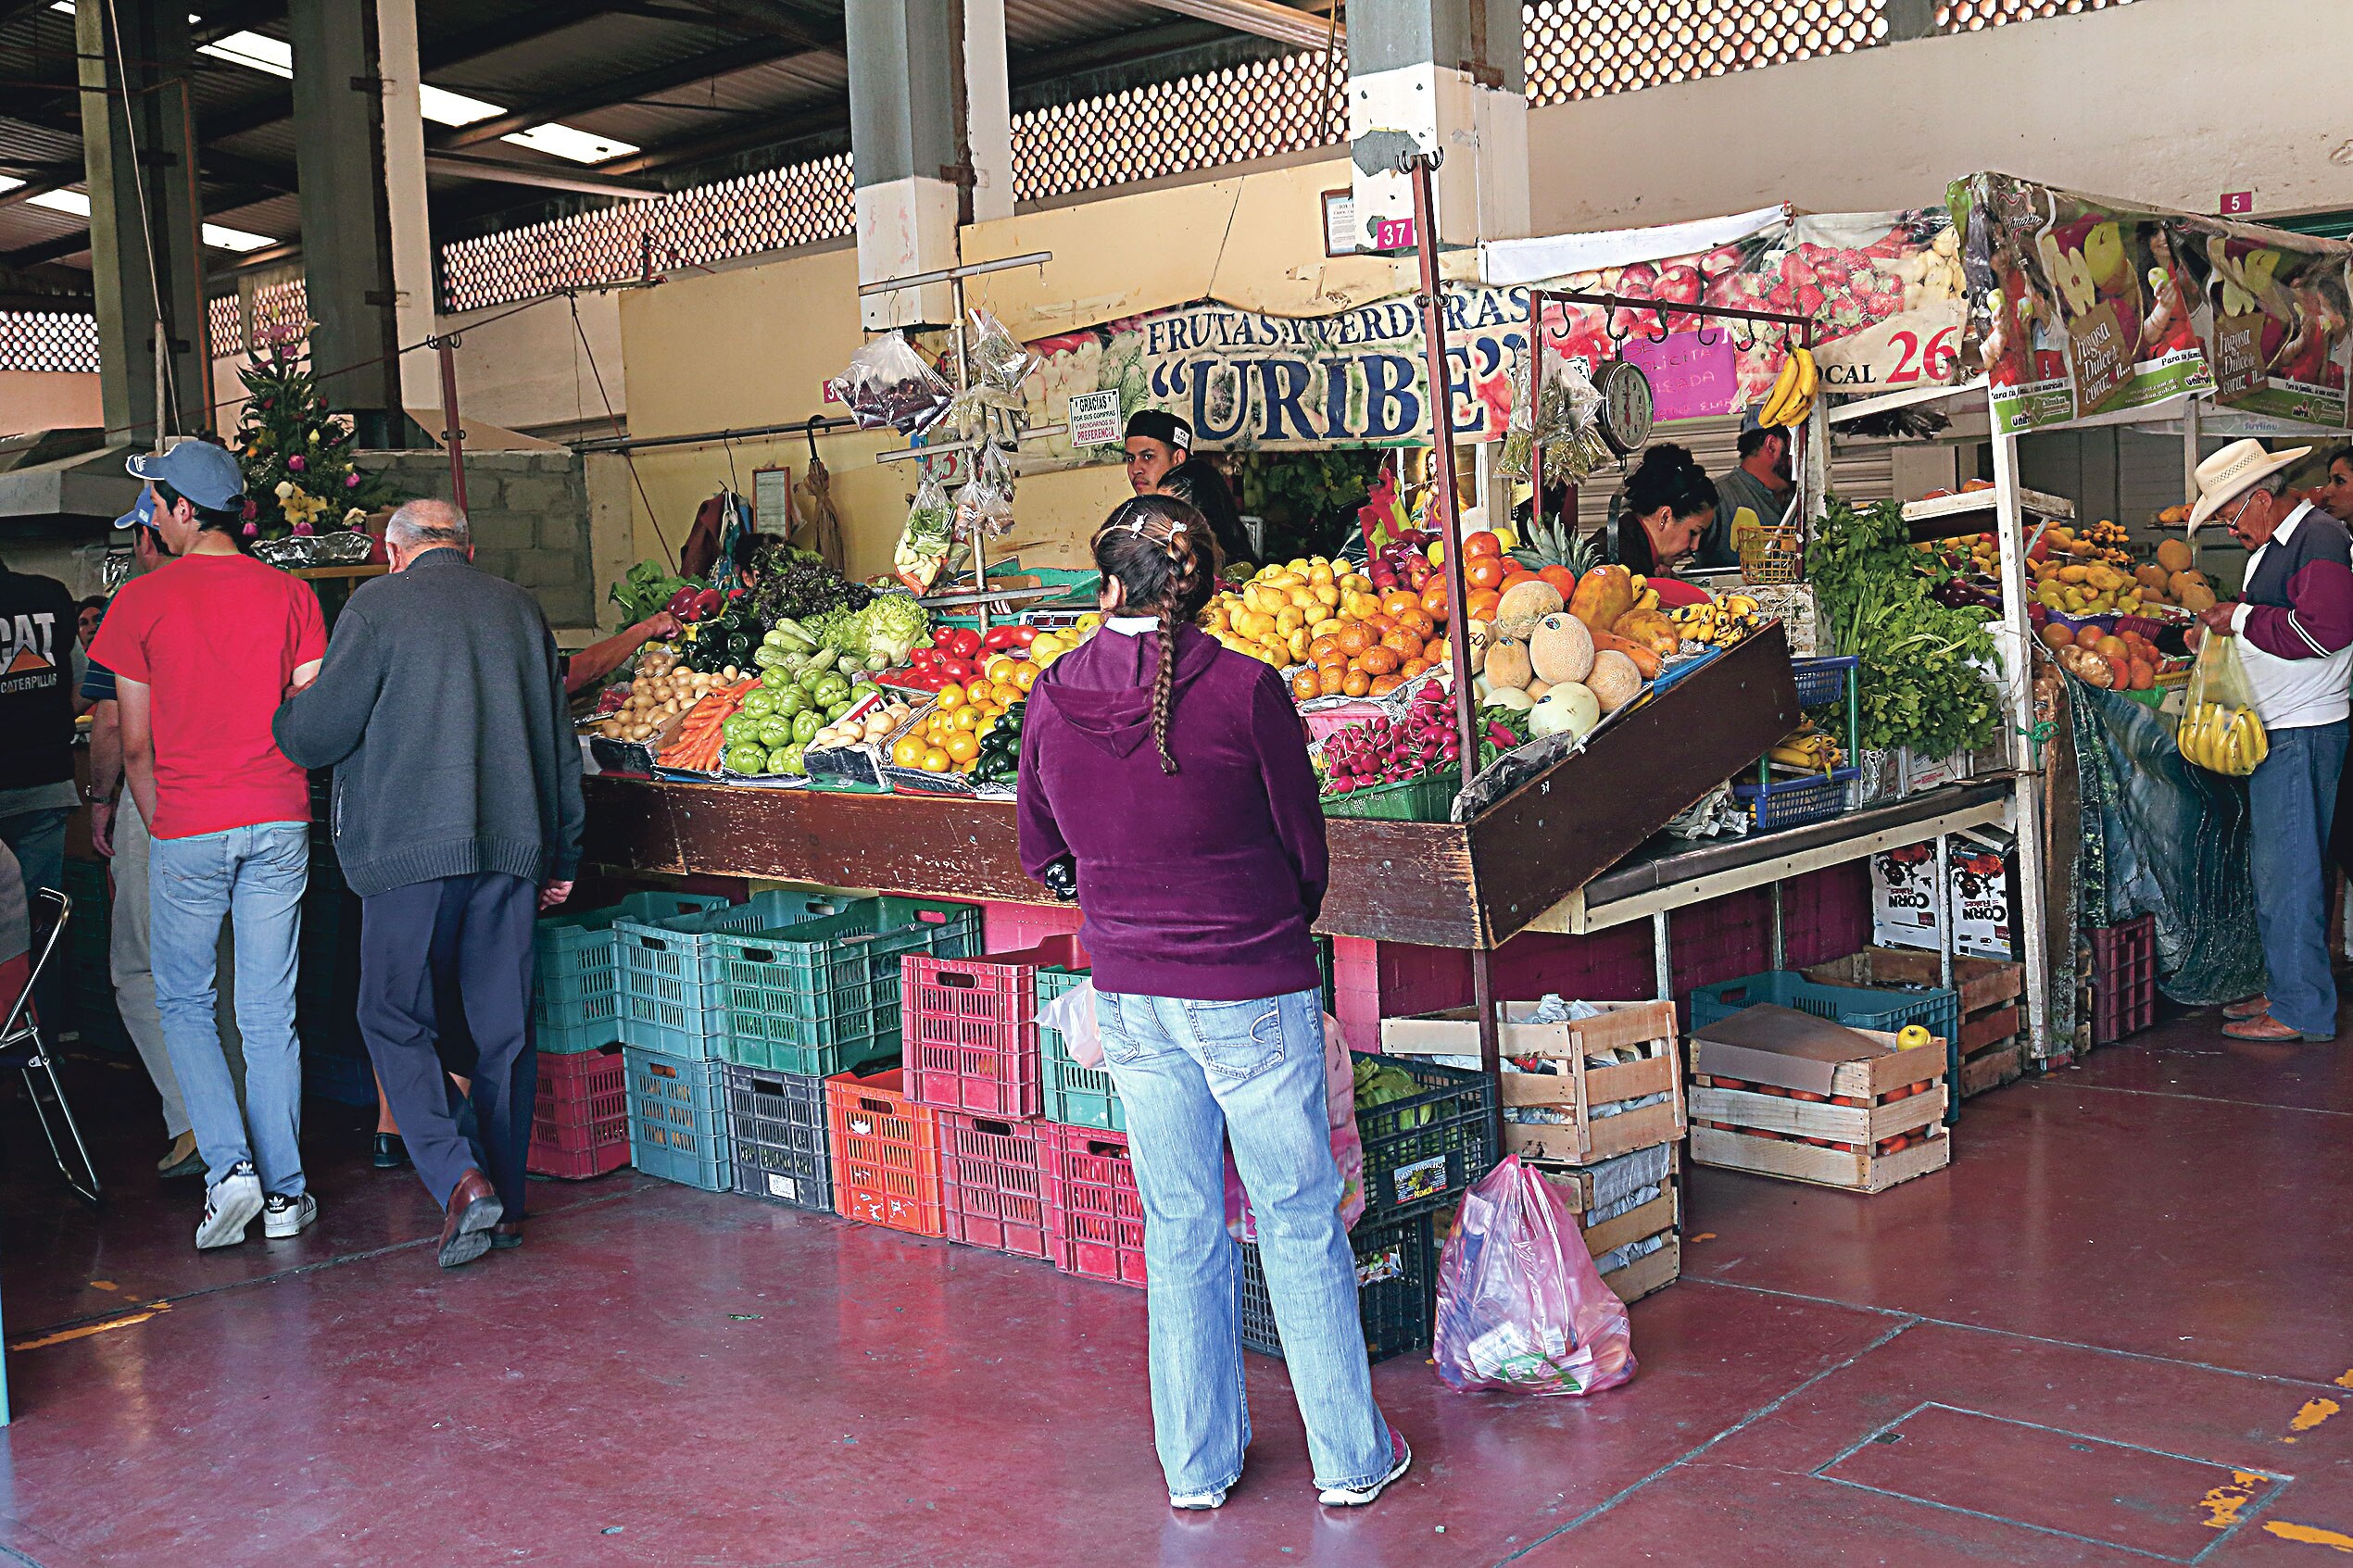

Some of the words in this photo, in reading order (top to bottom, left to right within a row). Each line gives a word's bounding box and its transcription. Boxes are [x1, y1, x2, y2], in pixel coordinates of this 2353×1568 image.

[2232, 195, 2241, 211] 5
[1383, 222, 1406, 245] 37
[1147, 312, 1280, 356] FRUTAS
[1287, 317, 1307, 345] Y
[2077, 321, 2111, 366] Jugosa
[2218, 329, 2250, 358] Jugosa
[1623, 340, 1655, 359] SE
[1885, 325, 1958, 384] 26
[2084, 348, 2111, 382] Dulce
[2161, 357, 2181, 367] Para
[2224, 352, 2249, 375] Dulce
[2085, 363, 2131, 405] corazn...
[2223, 370, 2265, 395] corazn...
[1079, 395, 1107, 412] GRACIAS
[1991, 391, 2007, 400] ara
[1093, 411, 1116, 420] COMPRAS
[1077, 427, 1114, 441] PREFERENCIA
[1, 673, 57, 694] CATERPILLAR
[1889, 893, 1930, 909] CORN
[1962, 905, 2007, 922] CORN
